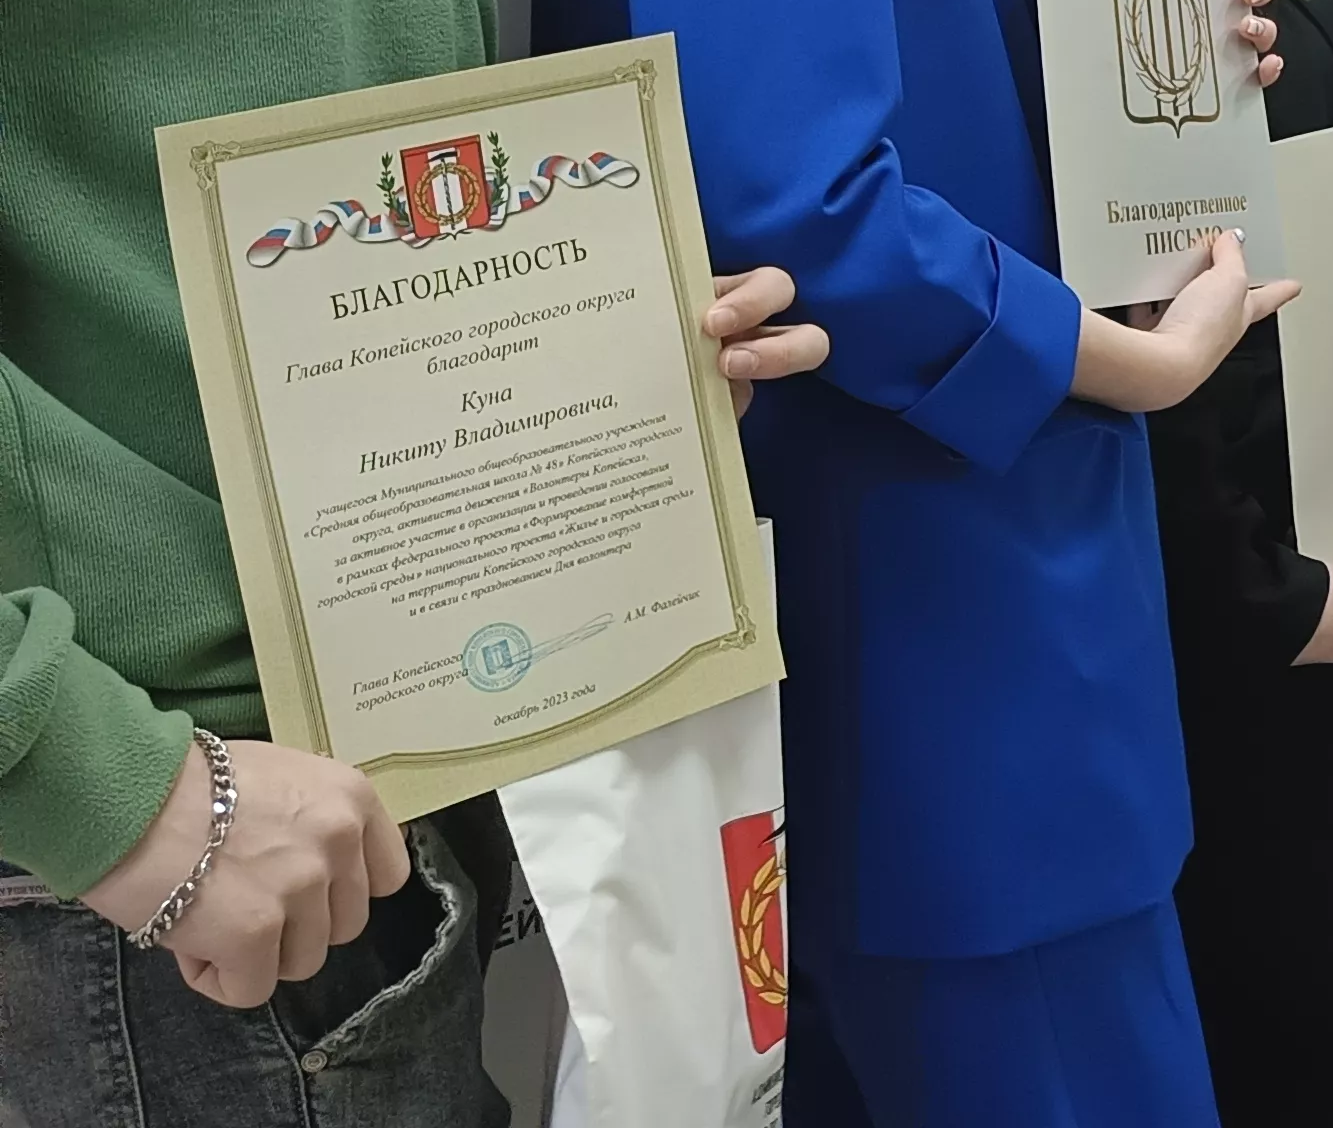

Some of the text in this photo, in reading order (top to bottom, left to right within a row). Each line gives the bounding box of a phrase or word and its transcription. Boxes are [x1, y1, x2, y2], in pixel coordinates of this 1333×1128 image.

[1107, 195, 1248, 224] Благодарственное
[330, 238, 588, 320] БЛАГОДАРНОСТЬ
[285, 287, 636, 384] Глава Копейского городского округа
[426, 335, 540, 375] благодарит
[359, 393, 619, 474] Никиту Владимировича,
[461, 386, 513, 416] Куна
[303, 516, 360, 539] «Средняя
[362, 479, 491, 524] общеобразовательная
[493, 469, 528, 487] школа
[530, 462, 543, 477] №
[567, 442, 627, 467] Копейского
[629, 425, 683, 450] городского
[316, 413, 667, 521] учащегося Муниципального общеобразовательного учреждения
[352, 454, 649, 544] округа, активиста движения «Волонтеры Копейска»,
[317, 489, 695, 609] городской среды» национального проекта «Жилье и городская среда»
[334, 463, 671, 568] за активное участие в организации и проведении голосования
[336, 476, 674, 585] в рамках федерального проекта «Формирование комфортной
[391, 521, 642, 604] на территории Копейского городского округа
[409, 541, 632, 617] и в связи с празднованием Дня волонтера
[650, 590, 700, 613] Фалейчик
[352, 652, 464, 696] Глава Копейского
[355, 668, 469, 712] городского округа
[494, 683, 597, 727] декабрь 2023 года
